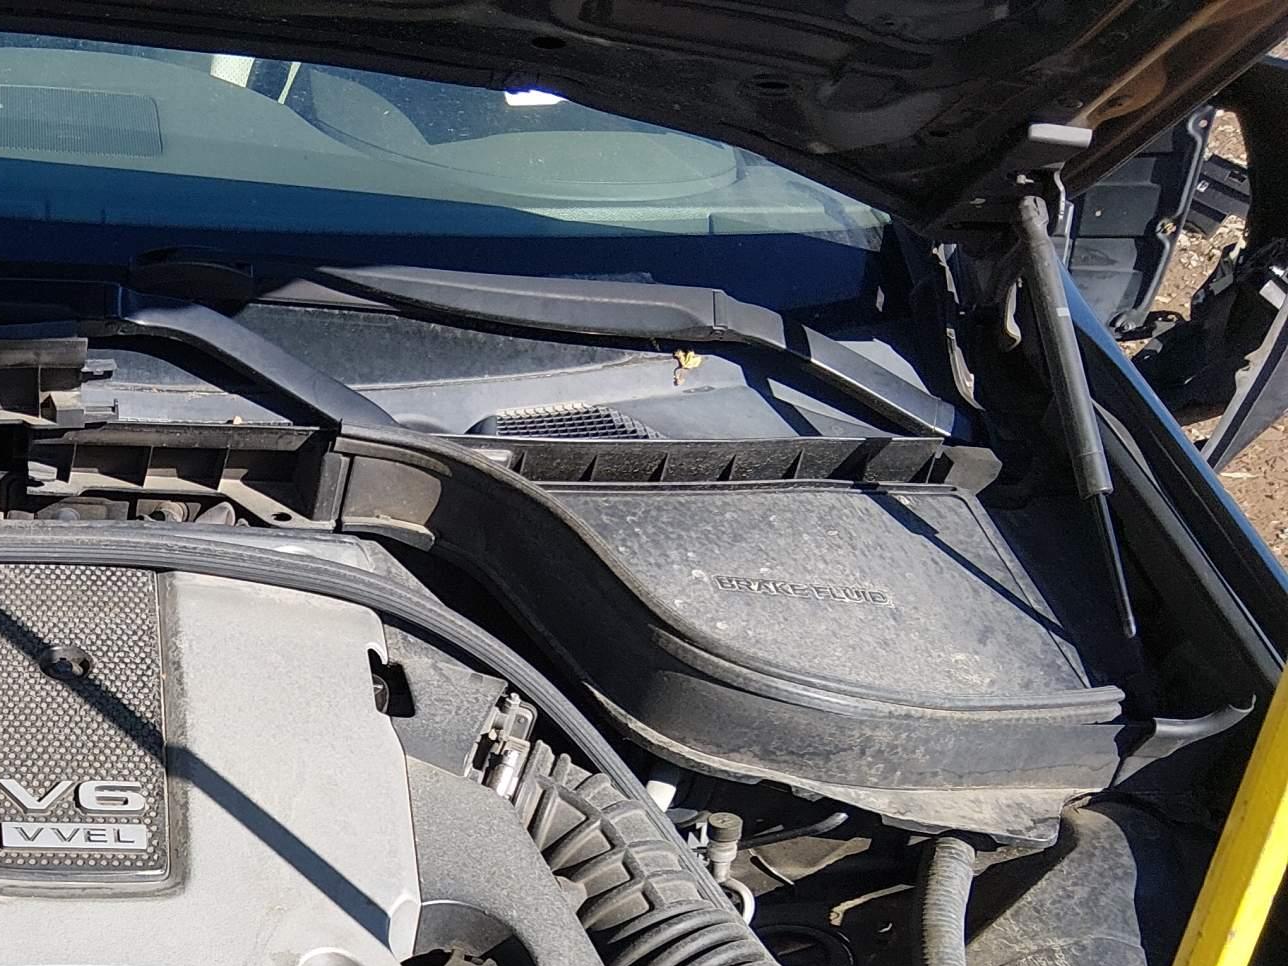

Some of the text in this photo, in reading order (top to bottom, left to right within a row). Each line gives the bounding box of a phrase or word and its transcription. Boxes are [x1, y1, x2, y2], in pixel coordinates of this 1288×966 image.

[713, 575, 892, 606] BRAKE FLUID
[13, 826, 136, 844] VVEL
